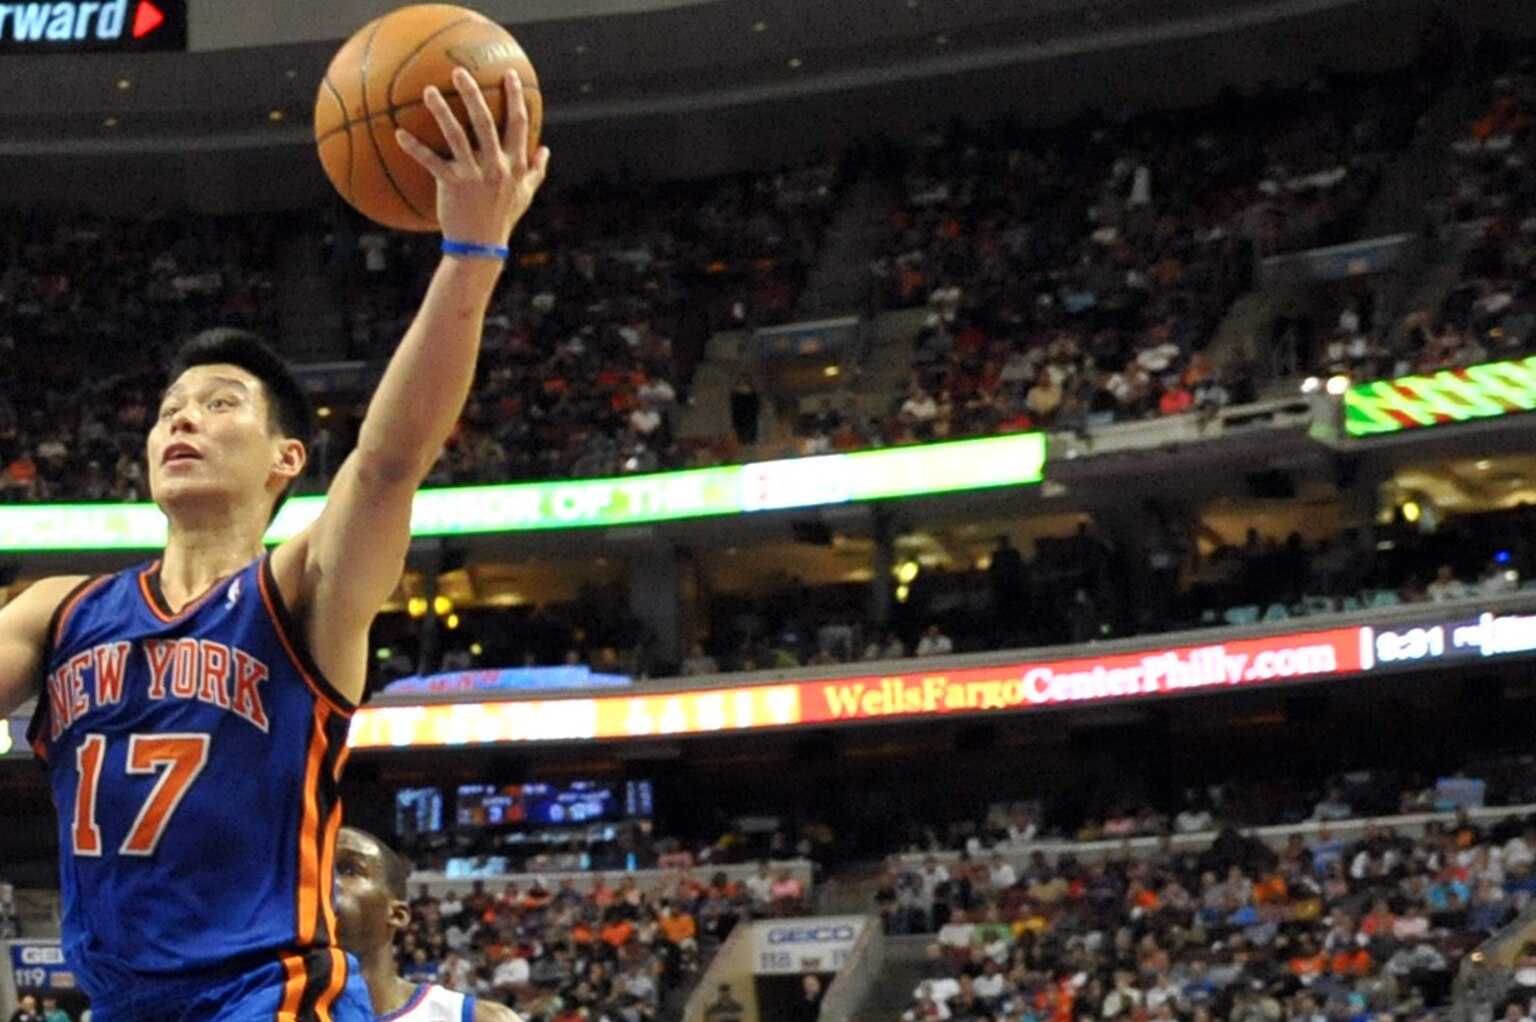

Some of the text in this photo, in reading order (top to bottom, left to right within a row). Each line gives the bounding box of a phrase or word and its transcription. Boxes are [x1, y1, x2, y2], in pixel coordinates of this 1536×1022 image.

[47, 640, 131, 742] NEW
[143, 637, 269, 734] YORK
[824, 643, 1336, 717] WellsFargoCenterPhilly.com
[71, 732, 211, 858] 17
[15, 967, 46, 987] 119
